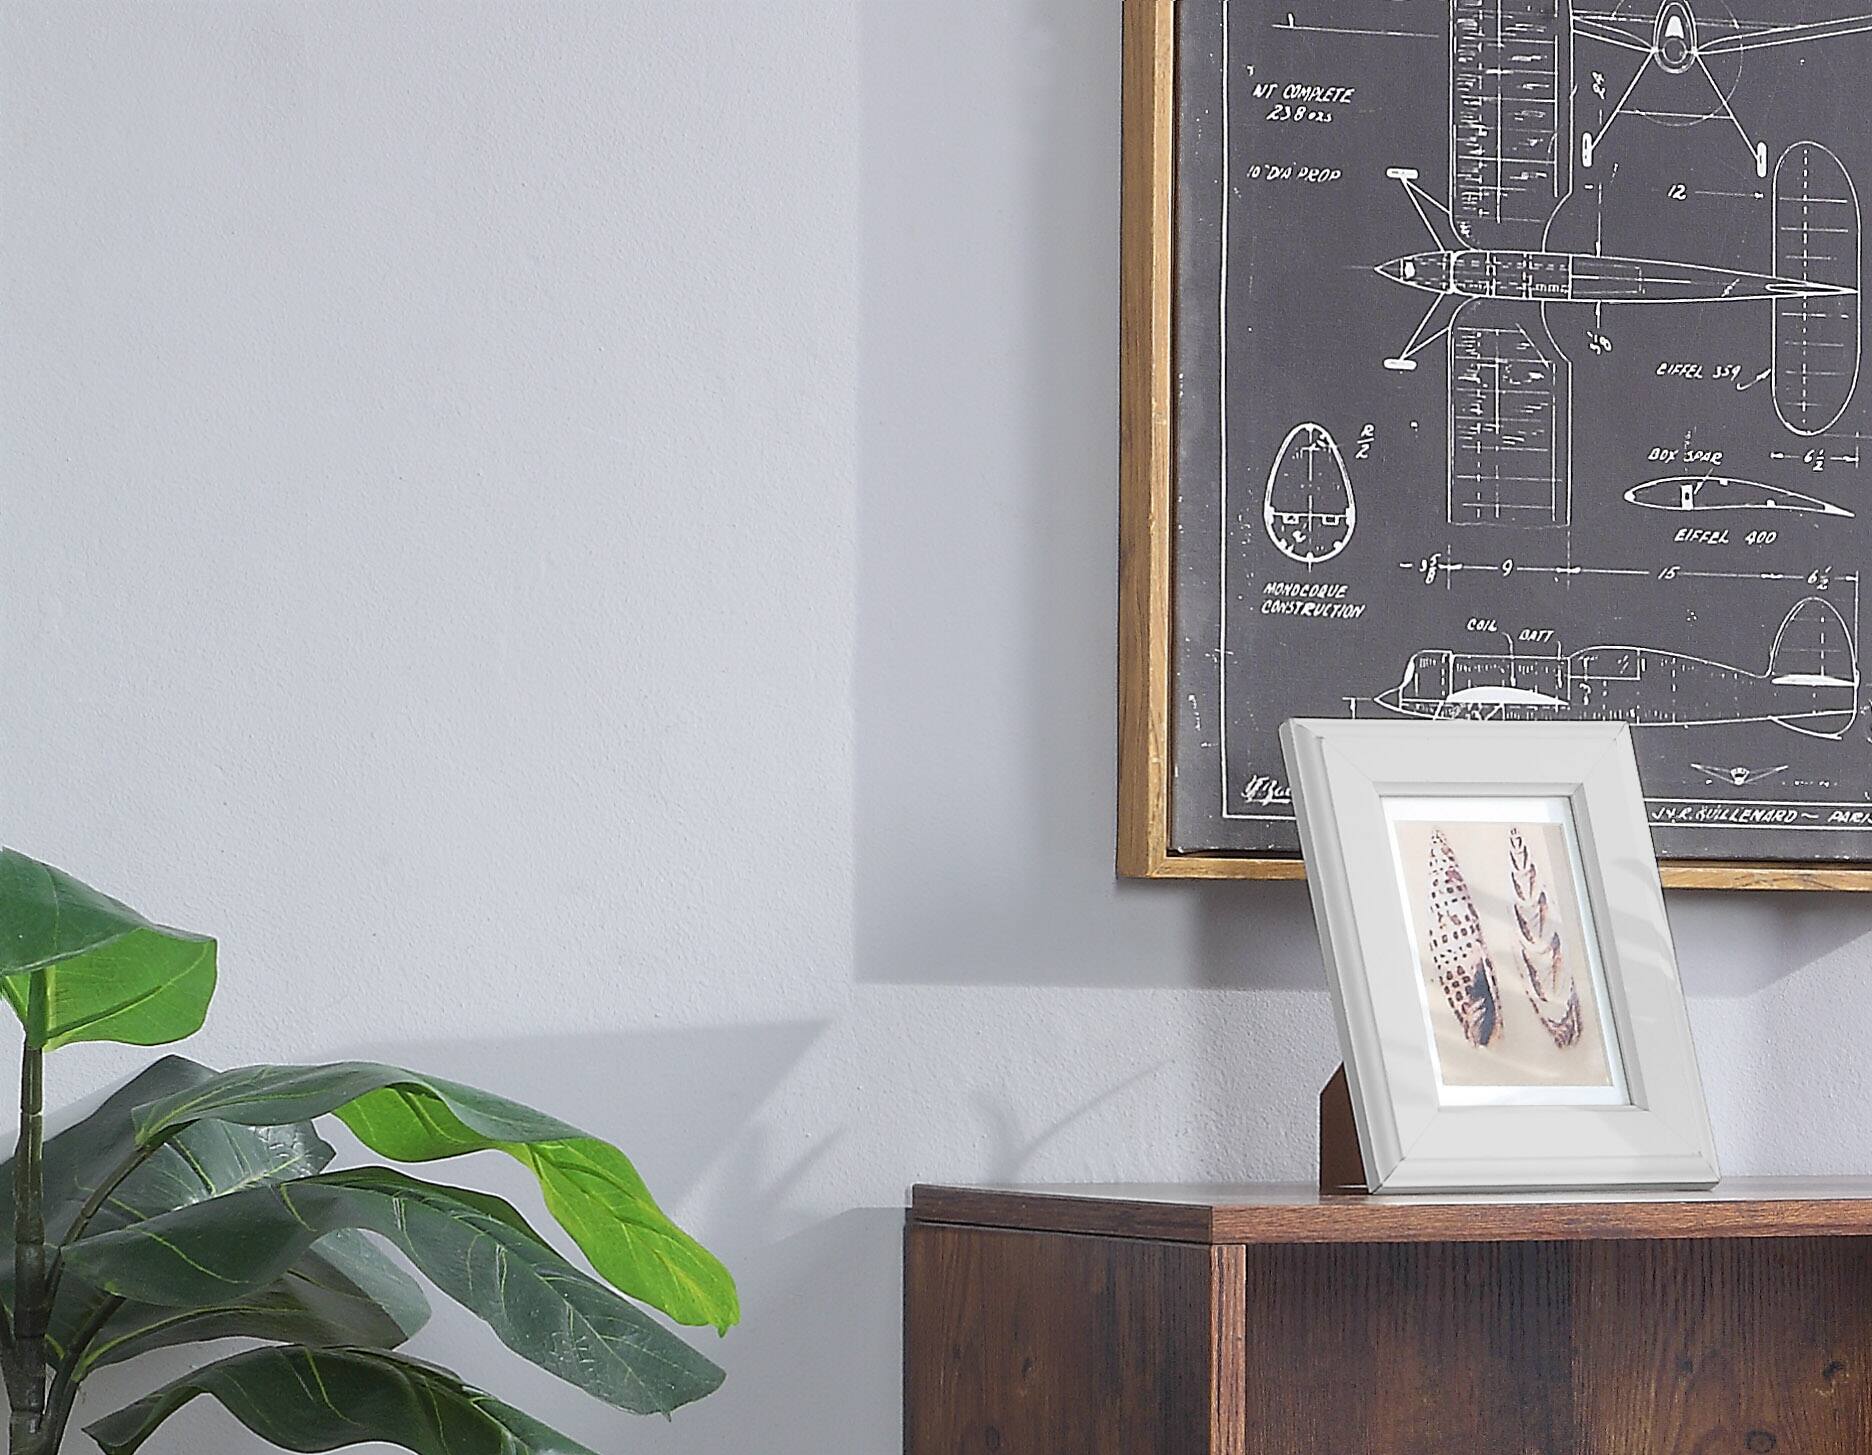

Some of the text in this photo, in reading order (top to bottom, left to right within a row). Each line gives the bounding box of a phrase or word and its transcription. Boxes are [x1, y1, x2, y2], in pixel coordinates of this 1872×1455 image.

[1282, 84, 1355, 103] COMPLETE
[1296, 167, 1342, 182] PROP
[1667, 184, 1687, 200] 12
[1712, 365, 1741, 381] 359
[1674, 528, 1777, 544] EIFFEL 400
[1501, 559, 1514, 577] 9
[1261, 600, 1365, 618] CONSTRUCTION
[1466, 618, 1497, 632] COIL
